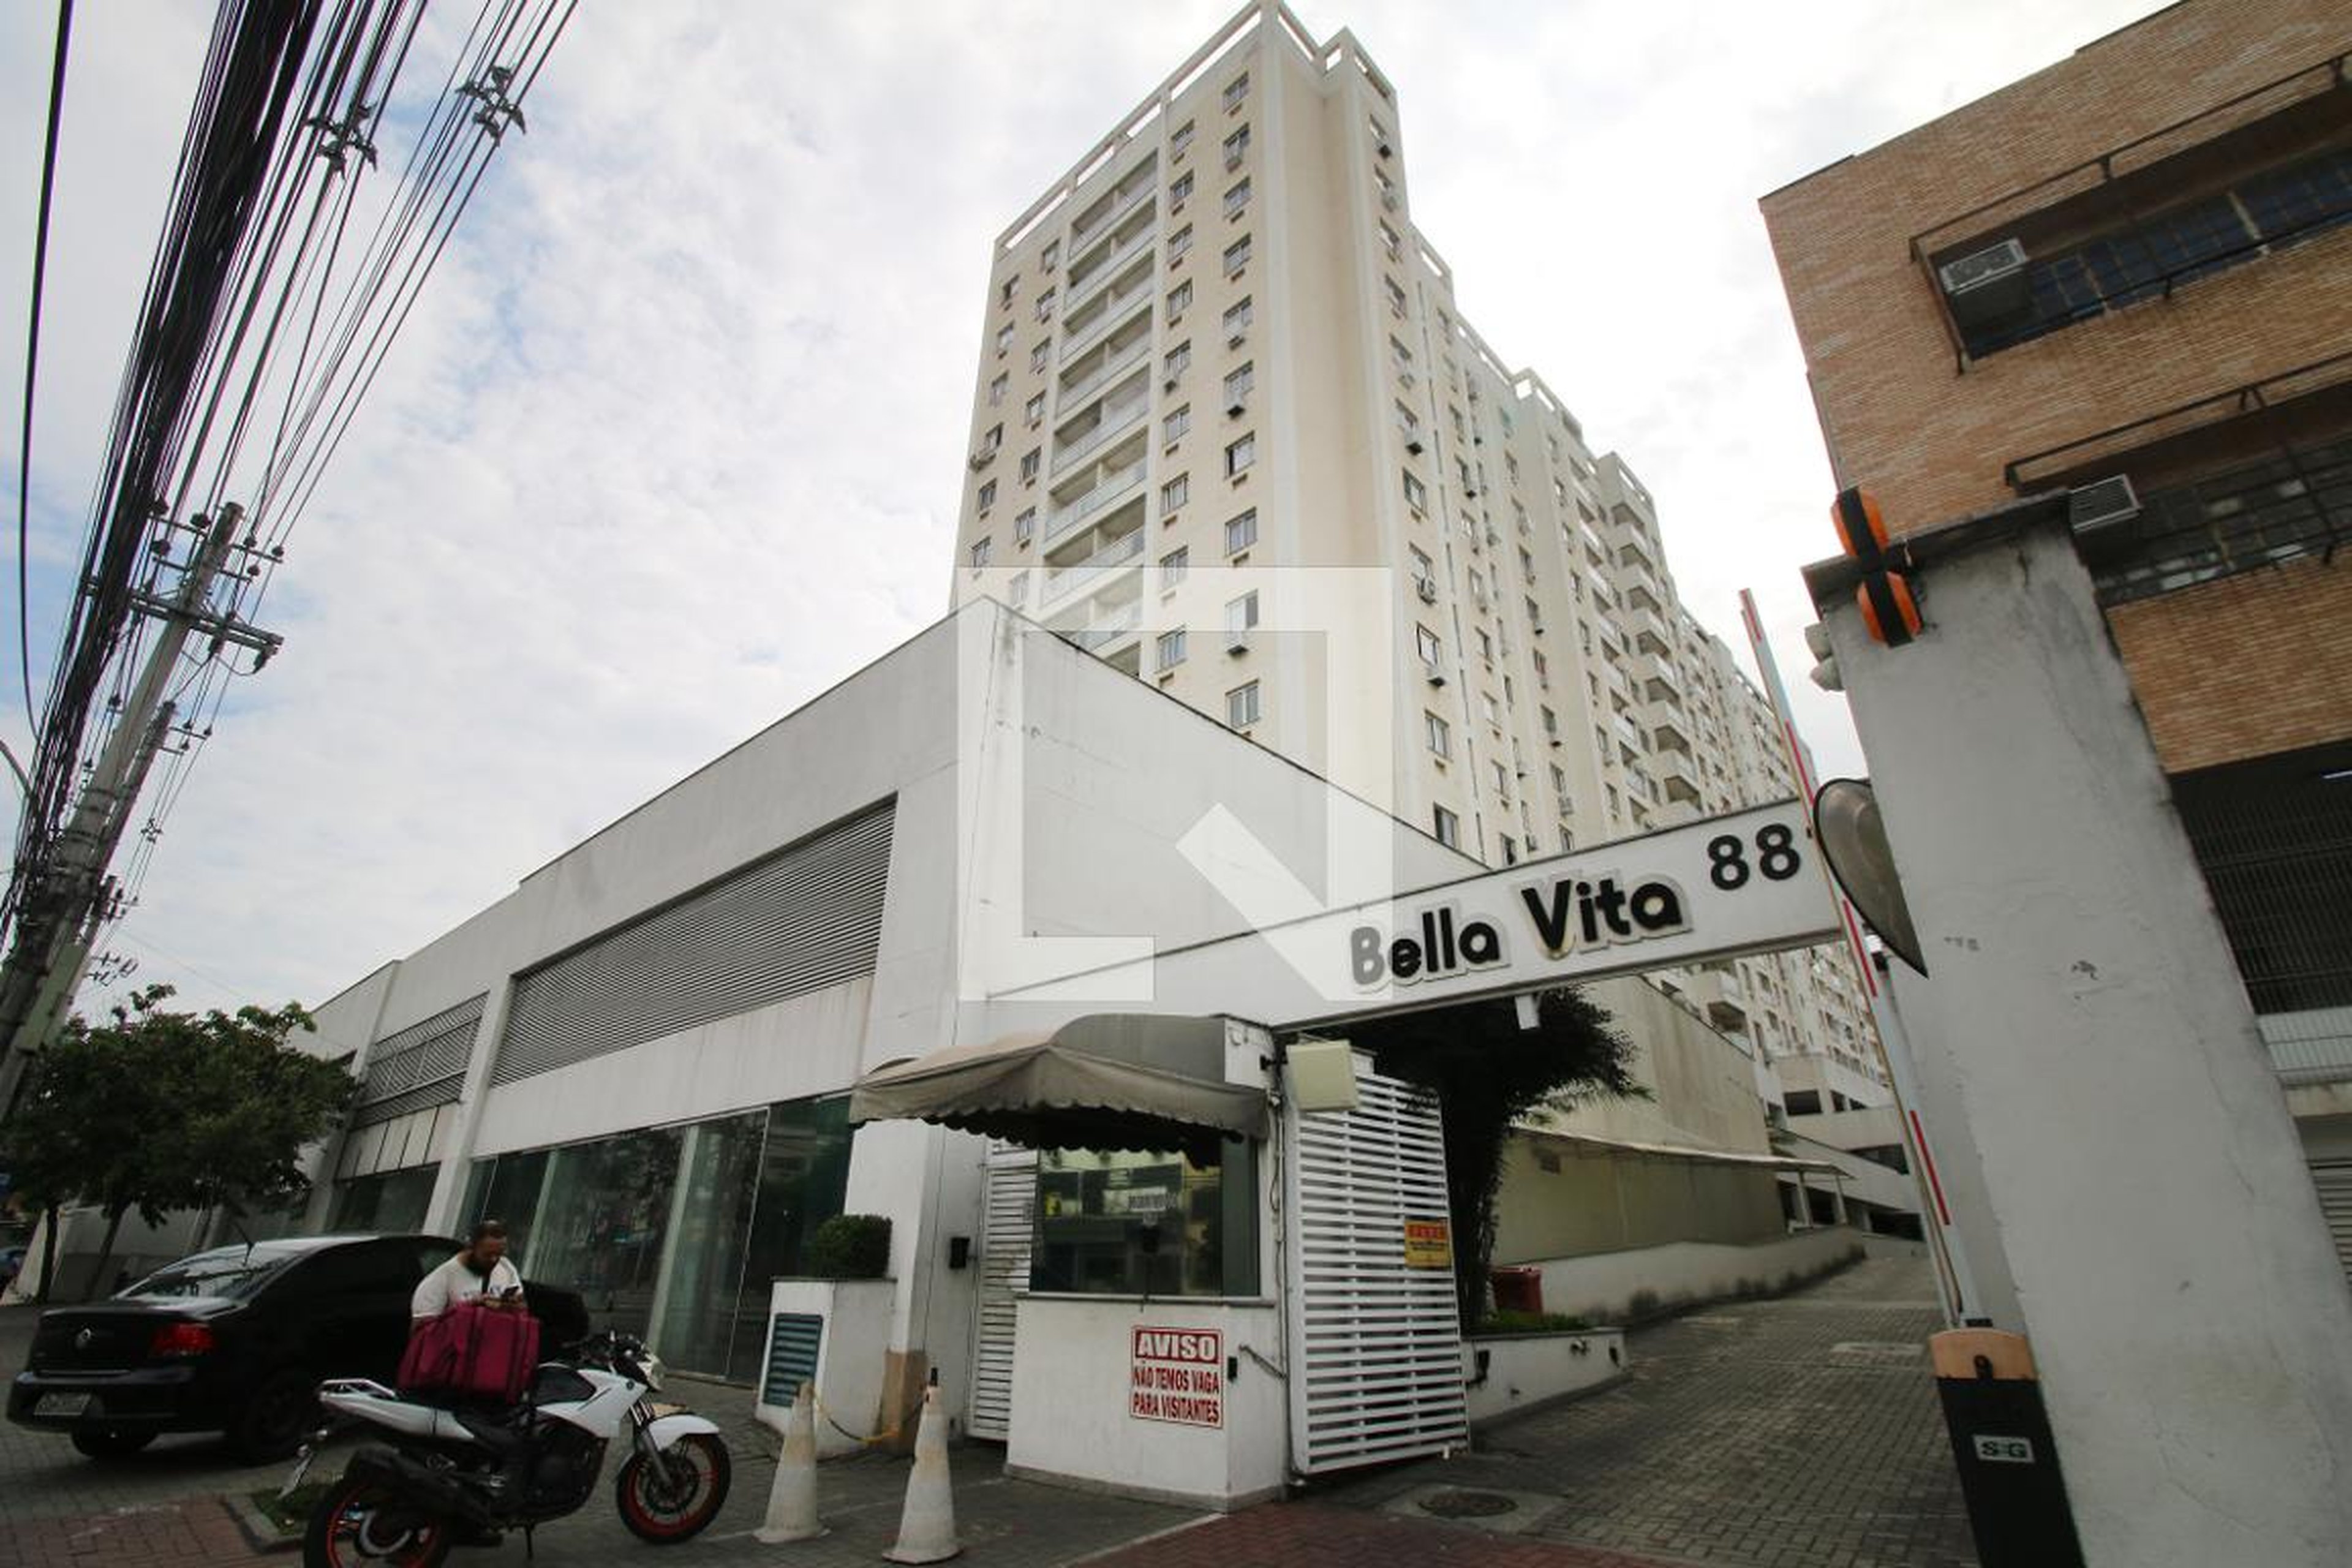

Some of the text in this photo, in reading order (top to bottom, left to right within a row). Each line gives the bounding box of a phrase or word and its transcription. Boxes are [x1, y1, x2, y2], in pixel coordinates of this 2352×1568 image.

[1351, 823, 1801, 985] Bella Vita 88
[1137, 1332, 1216, 1361] AVISO
[1134, 1360, 1219, 1394] NÃO TEMOS VAGA
[1133, 1392, 1219, 1423] PARA VISITANTES
